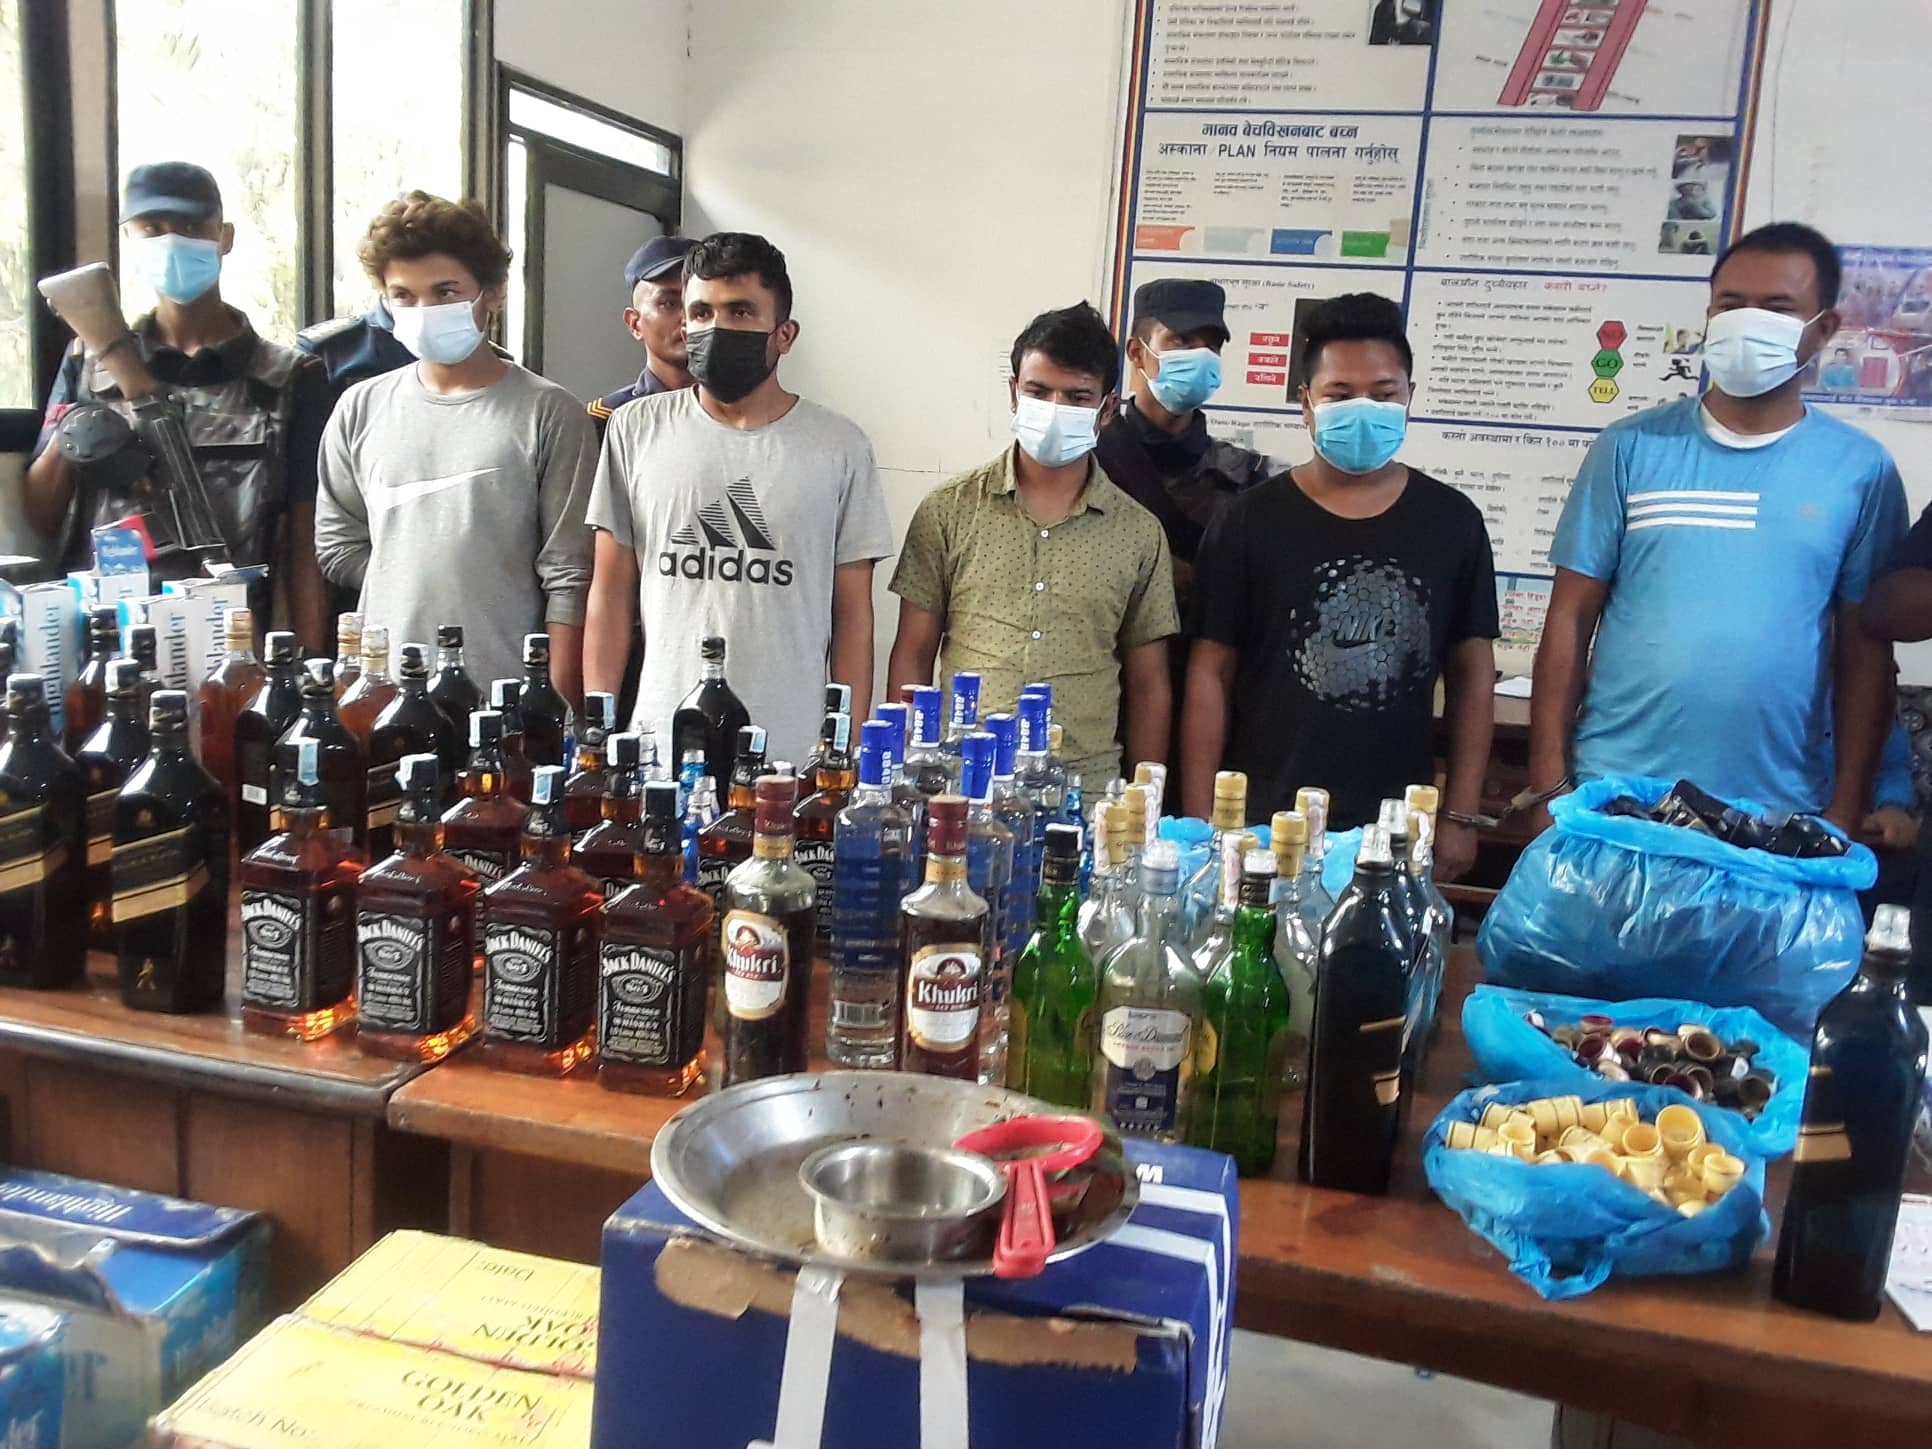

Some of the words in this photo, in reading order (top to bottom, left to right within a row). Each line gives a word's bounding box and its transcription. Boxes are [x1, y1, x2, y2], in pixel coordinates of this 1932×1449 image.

[1218, 143, 1256, 158] PLAN
[1264, 140, 1297, 157] नियम
[1596, 358, 1618, 368] GO
[659, 547, 794, 586] adidas
[602, 956, 629, 977] JACK
[630, 951, 677, 984] DANIEL'S
[917, 979, 978, 1004] Khukri
[401, 1369, 541, 1411] GOLDEN
[417, 1395, 487, 1422] OAK
